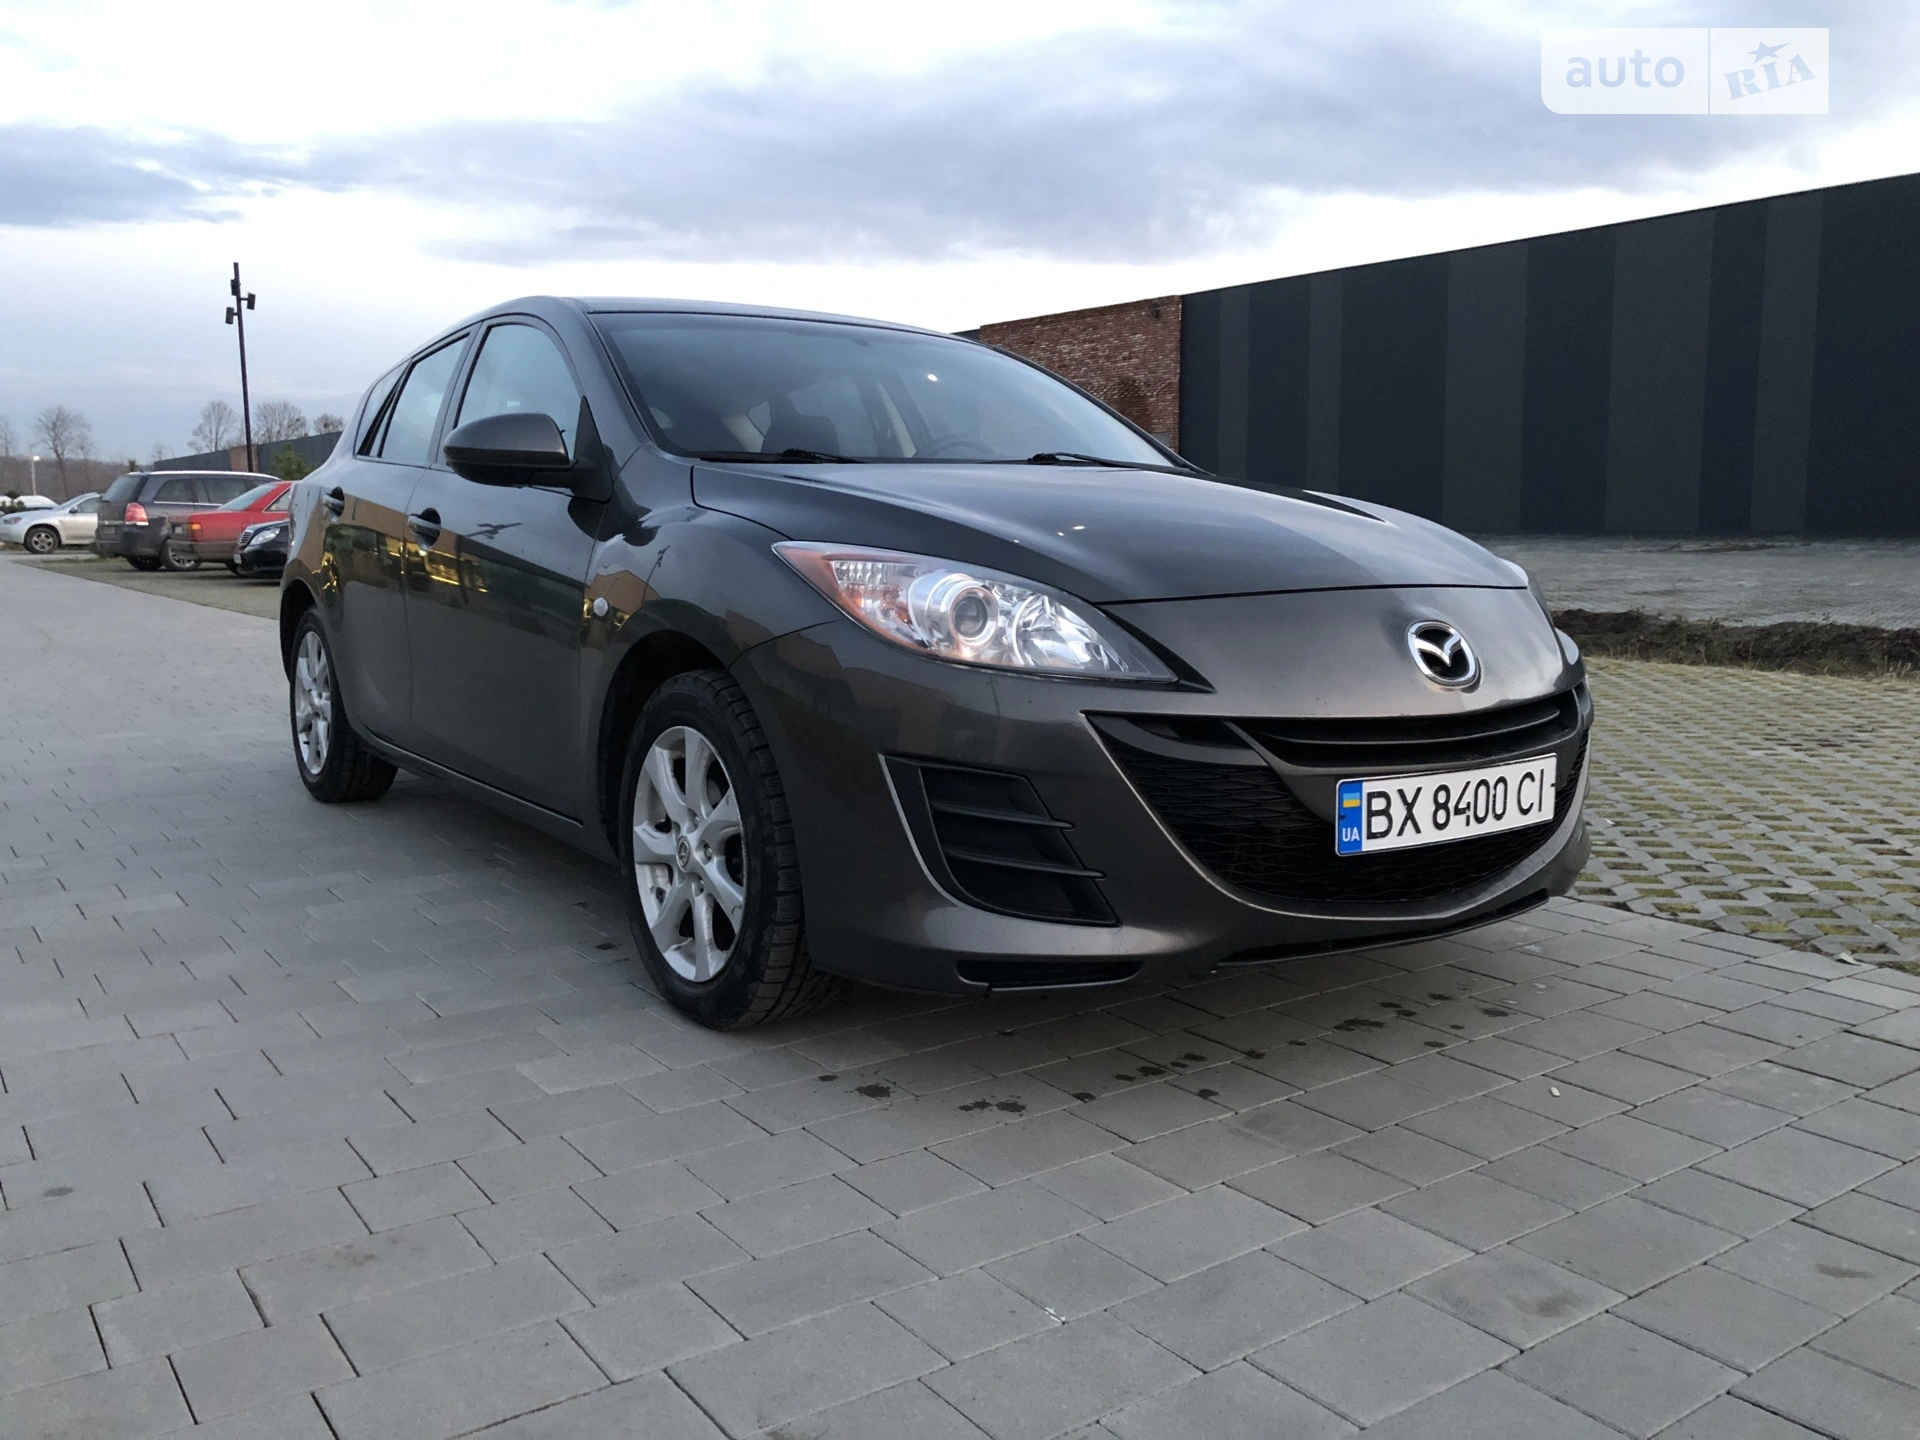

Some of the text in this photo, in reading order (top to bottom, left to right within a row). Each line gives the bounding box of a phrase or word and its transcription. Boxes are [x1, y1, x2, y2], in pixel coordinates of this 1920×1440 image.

[1366, 768, 1544, 840] BX 8400 CI
[1342, 827, 1360, 842] UA
